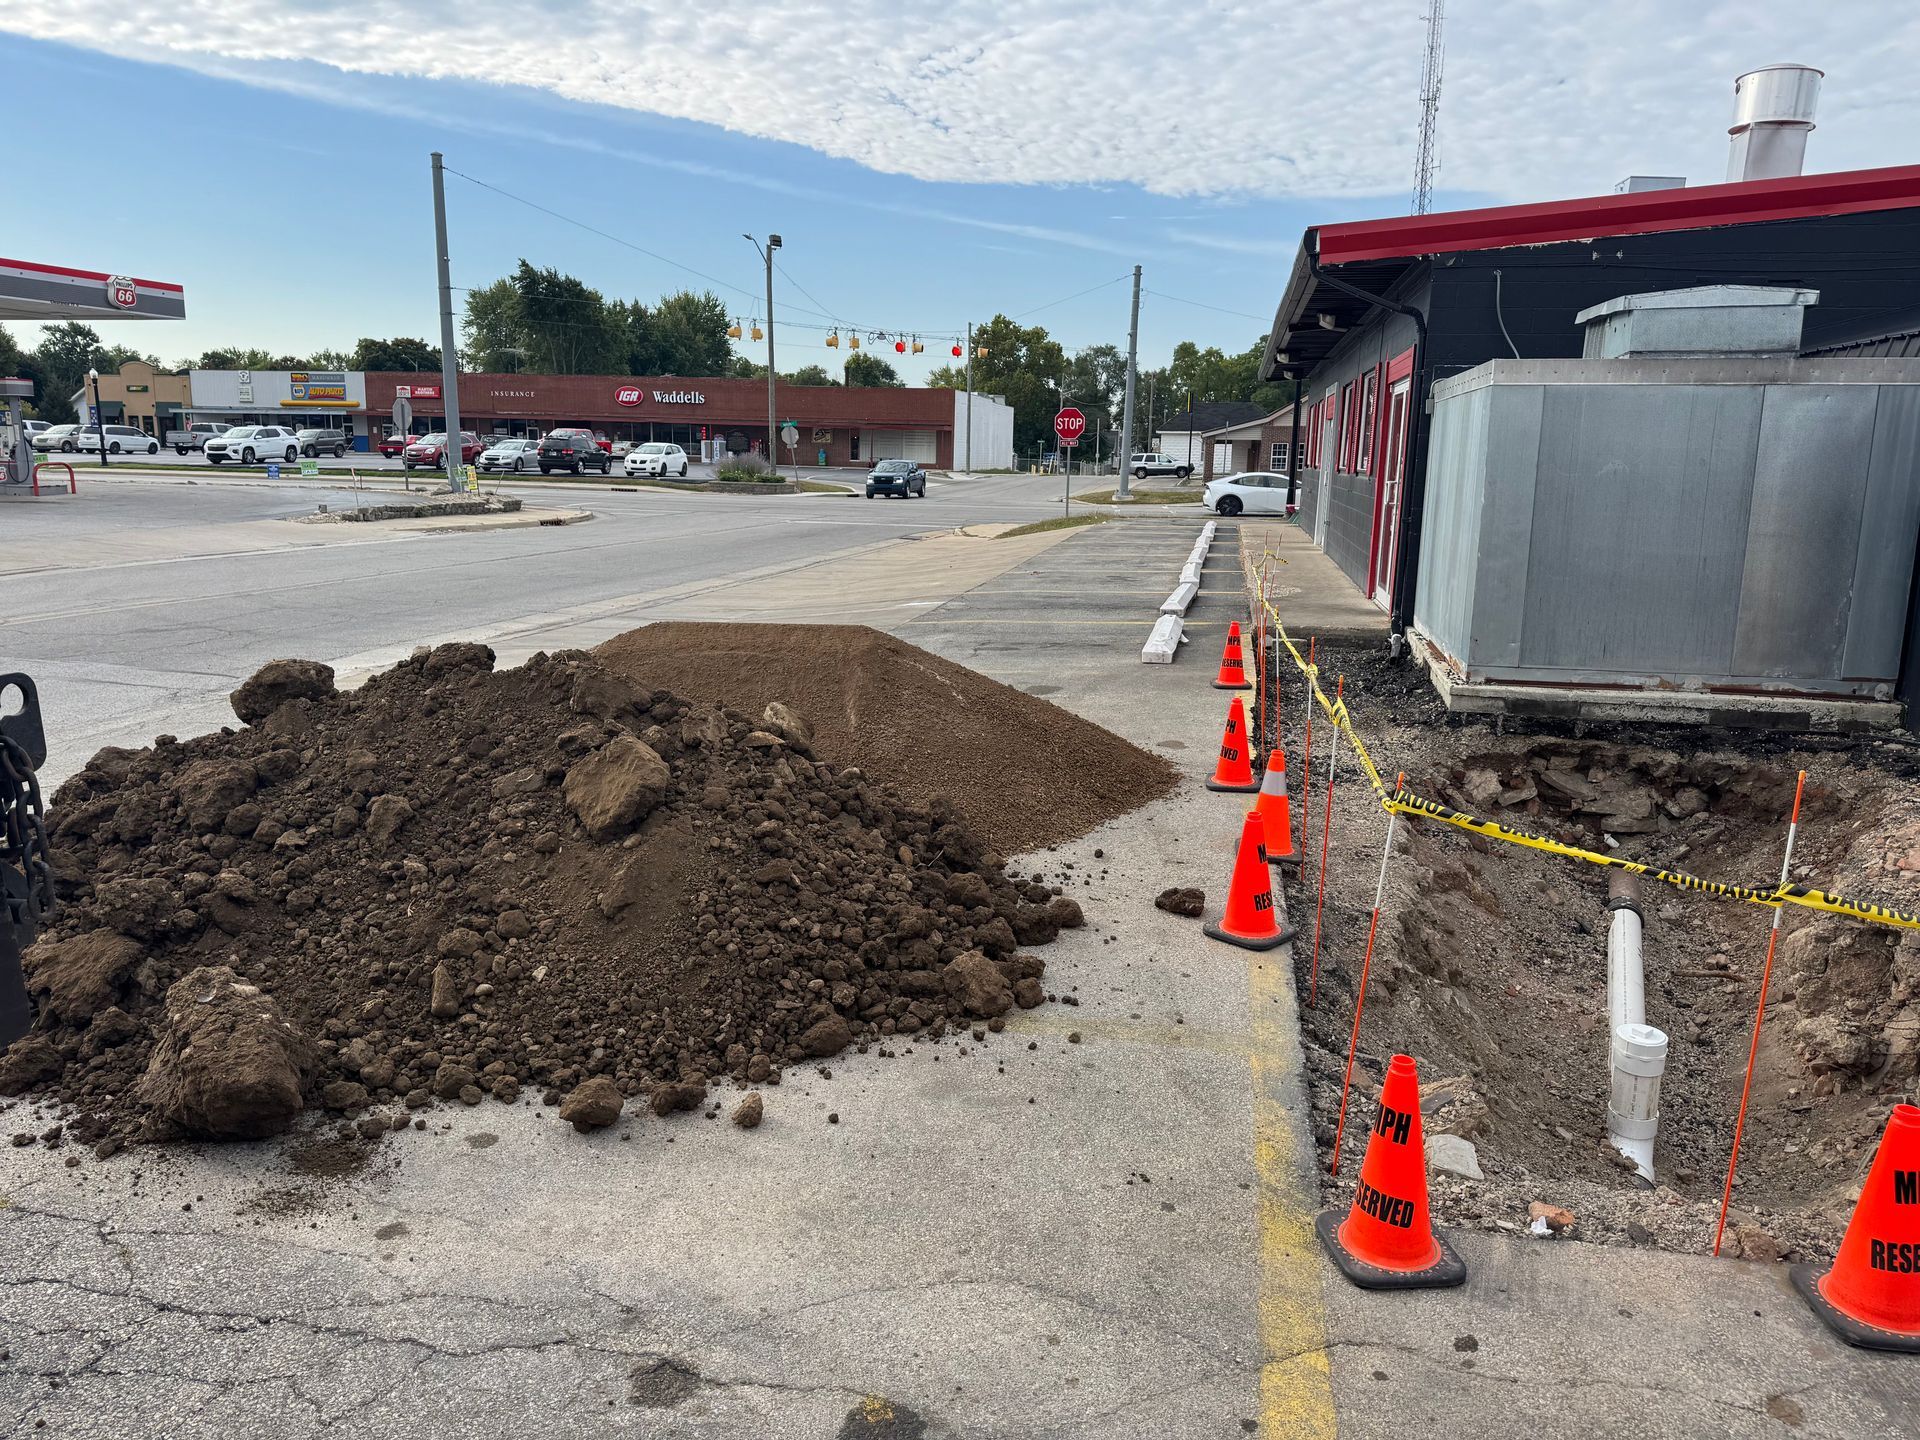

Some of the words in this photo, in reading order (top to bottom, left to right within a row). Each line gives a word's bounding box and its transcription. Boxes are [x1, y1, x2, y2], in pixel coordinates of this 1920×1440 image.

[118, 290, 133, 302] 66
[490, 390, 535, 398] INSURANCE
[619, 391, 639, 402] IGA
[652, 391, 705, 404] Waddells
[1056, 417, 1083, 430] STOP
